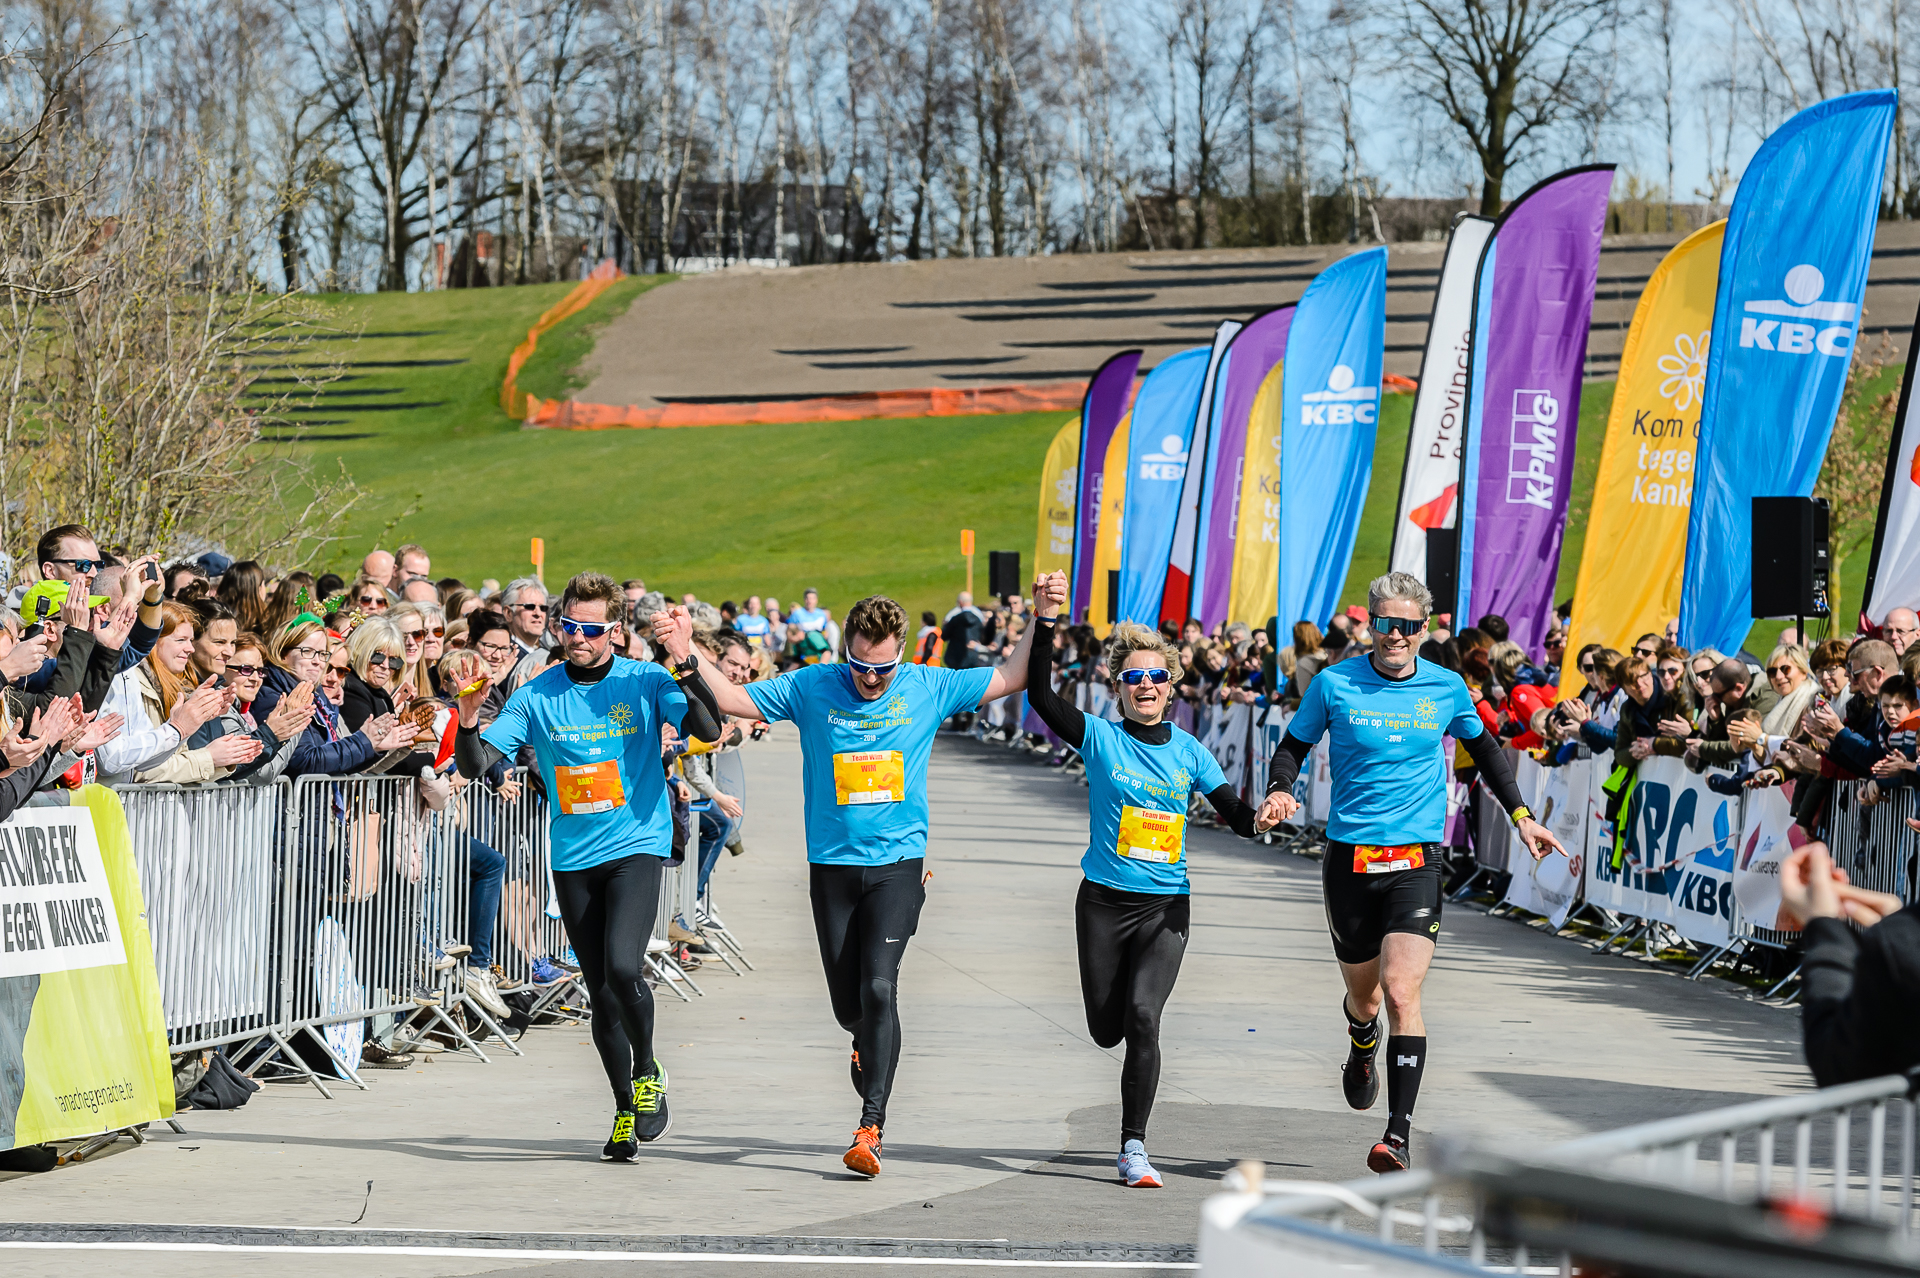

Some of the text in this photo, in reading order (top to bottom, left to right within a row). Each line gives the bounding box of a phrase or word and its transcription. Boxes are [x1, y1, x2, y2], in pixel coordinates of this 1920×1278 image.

[1739, 317, 1853, 357] KBC
[1301, 403, 1376, 425] KBC
[1632, 409, 1684, 438] Kom
[1525, 394, 1559, 510] KPMG
[1637, 442, 1695, 479] tege
[1139, 463, 1186, 481] KB
[1631, 475, 1693, 507] Kank
[827, 714, 914, 730] Kom op tegen Kanker
[1348, 714, 1440, 730] Kom op tegen Kanker
[549, 725, 639, 744] Kom op tegen Kanker
[860, 764, 877, 773] WIM
[576, 776, 594, 786] BART
[867, 778, 873, 786] 2
[1111, 768, 1130, 784] Kom
[1131, 779, 1142, 790] op
[1144, 782, 1168, 797] tegen
[586, 790, 592, 798] 2
[1142, 810, 1159, 819] Team
[1142, 821, 1169, 832] GOEDELE
[1151, 836, 1157, 845] 2
[1387, 849, 1393, 857] 2
[0, 897, 110, 952] EGEN KANKER
